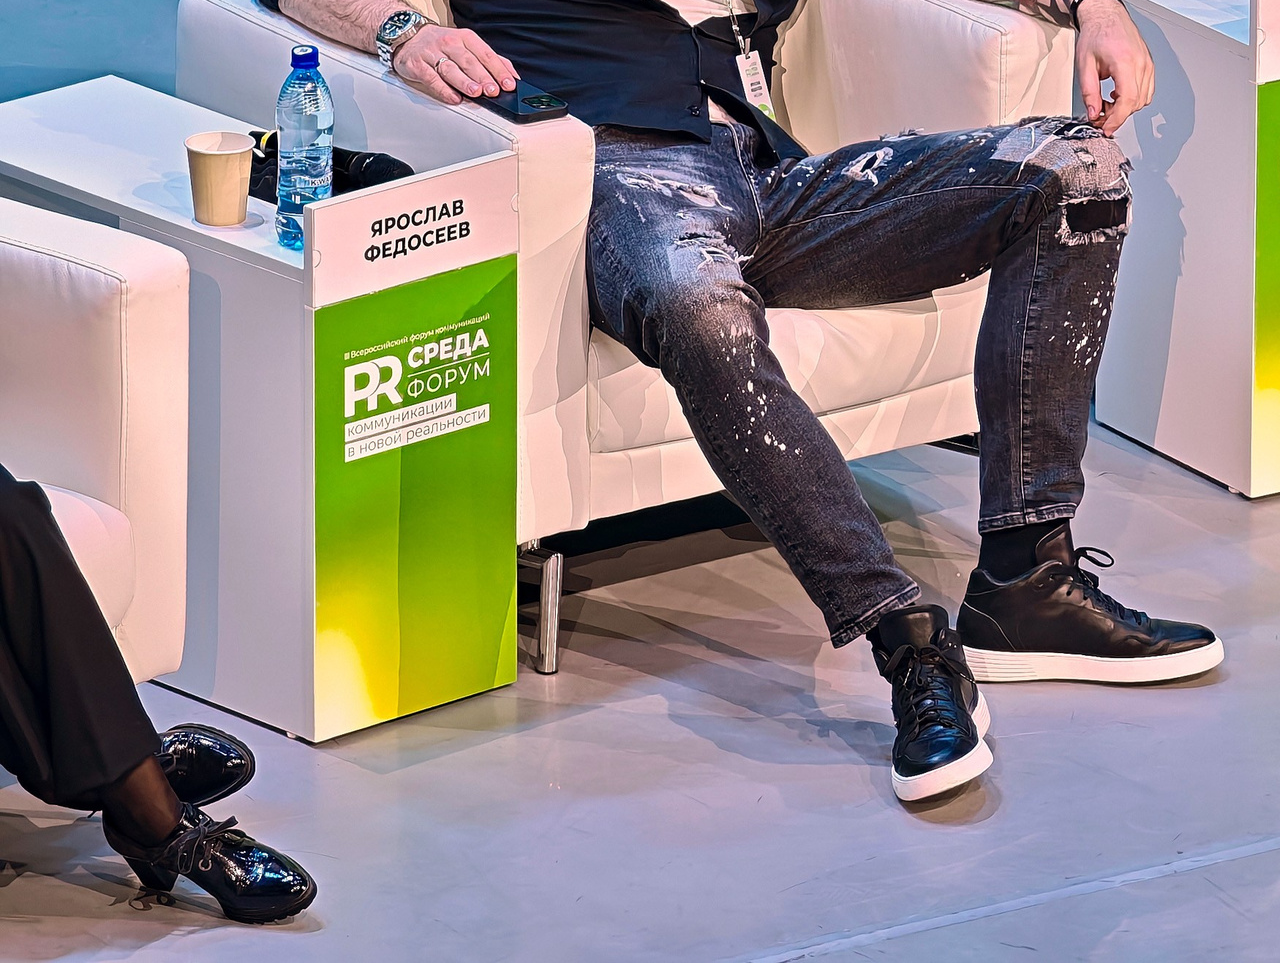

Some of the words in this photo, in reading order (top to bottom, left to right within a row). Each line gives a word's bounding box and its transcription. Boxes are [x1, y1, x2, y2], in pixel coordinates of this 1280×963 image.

[371, 199, 464, 237] ЯРОСЛАВ
[364, 221, 470, 262] ФЕДОСЕЕВ
[351, 336, 408, 358] Всероссийский
[409, 330, 434, 344] форум
[435, 312, 490, 334] коммуникаций
[407, 328, 489, 368] СРЕДА
[344, 355, 403, 418] PR
[407, 358, 490, 398] ФОРУМ
[348, 398, 452, 437] коммуникации
[348, 447, 355, 457] в
[359, 431, 402, 454] новой
[406, 408, 486, 443] реальности
